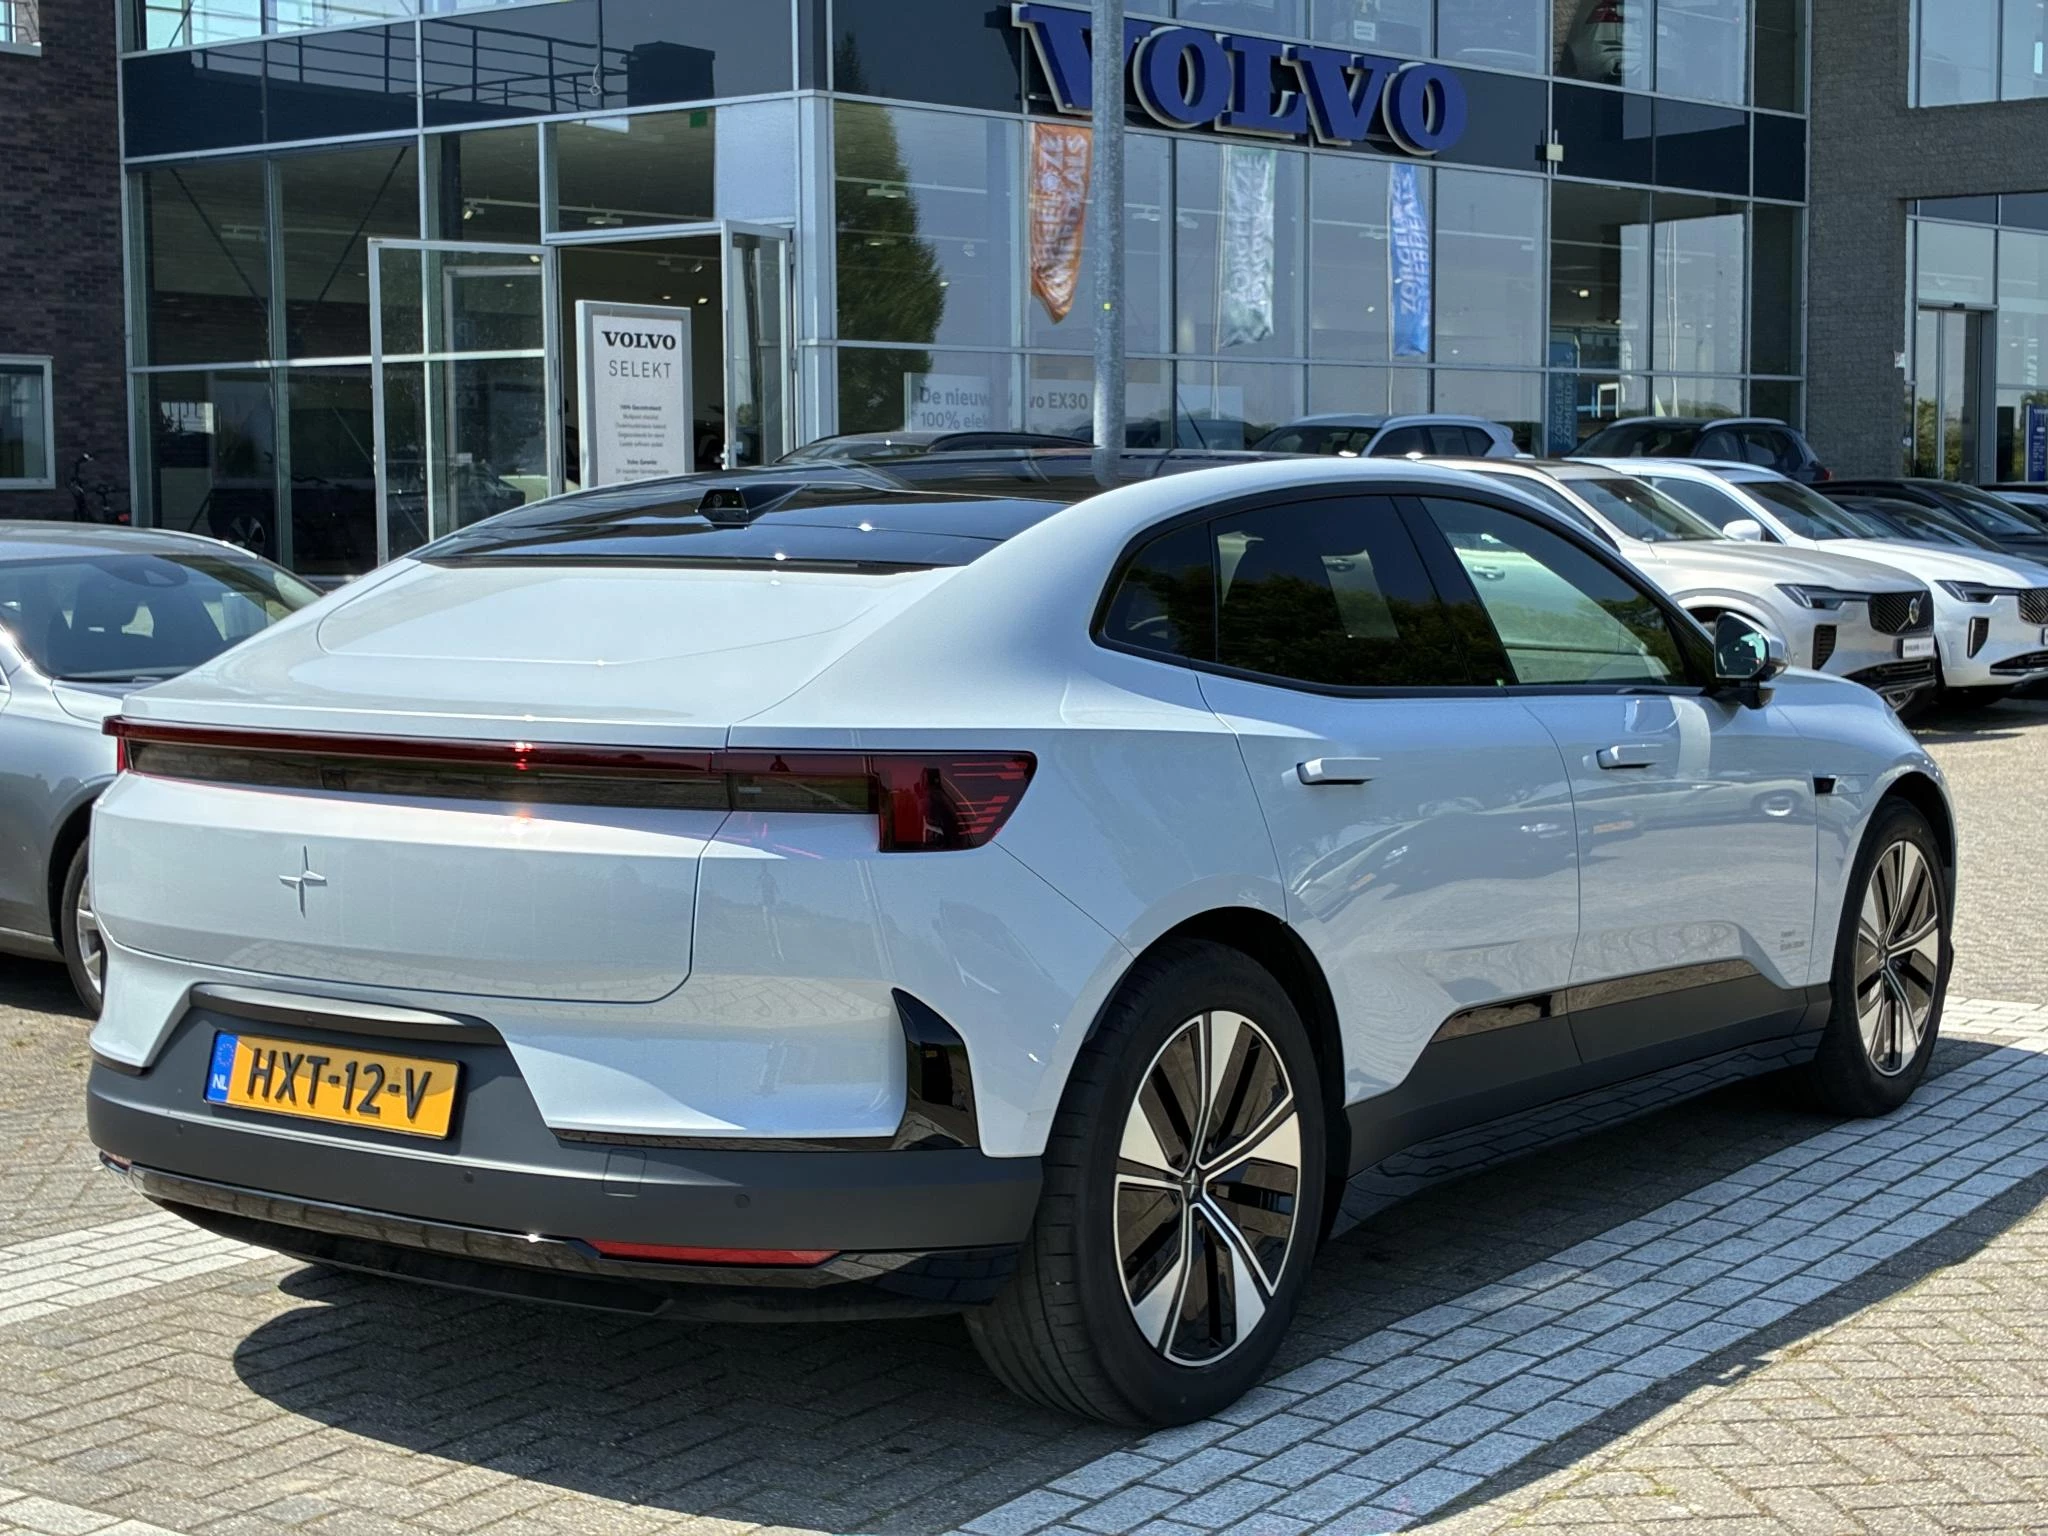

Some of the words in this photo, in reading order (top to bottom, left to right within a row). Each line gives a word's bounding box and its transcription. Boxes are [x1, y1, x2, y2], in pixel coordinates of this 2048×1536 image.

[1012, 3, 1468, 156] VOLVO
[602, 331, 676, 350] VOLVO
[608, 359, 671, 379] SELEKT
[920, 386, 941, 405] De
[1048, 392, 1088, 410] EX30
[921, 411, 960, 429] 100%
[212, 1073, 228, 1090] NL
[247, 1048, 432, 1121] HXT-12-V
